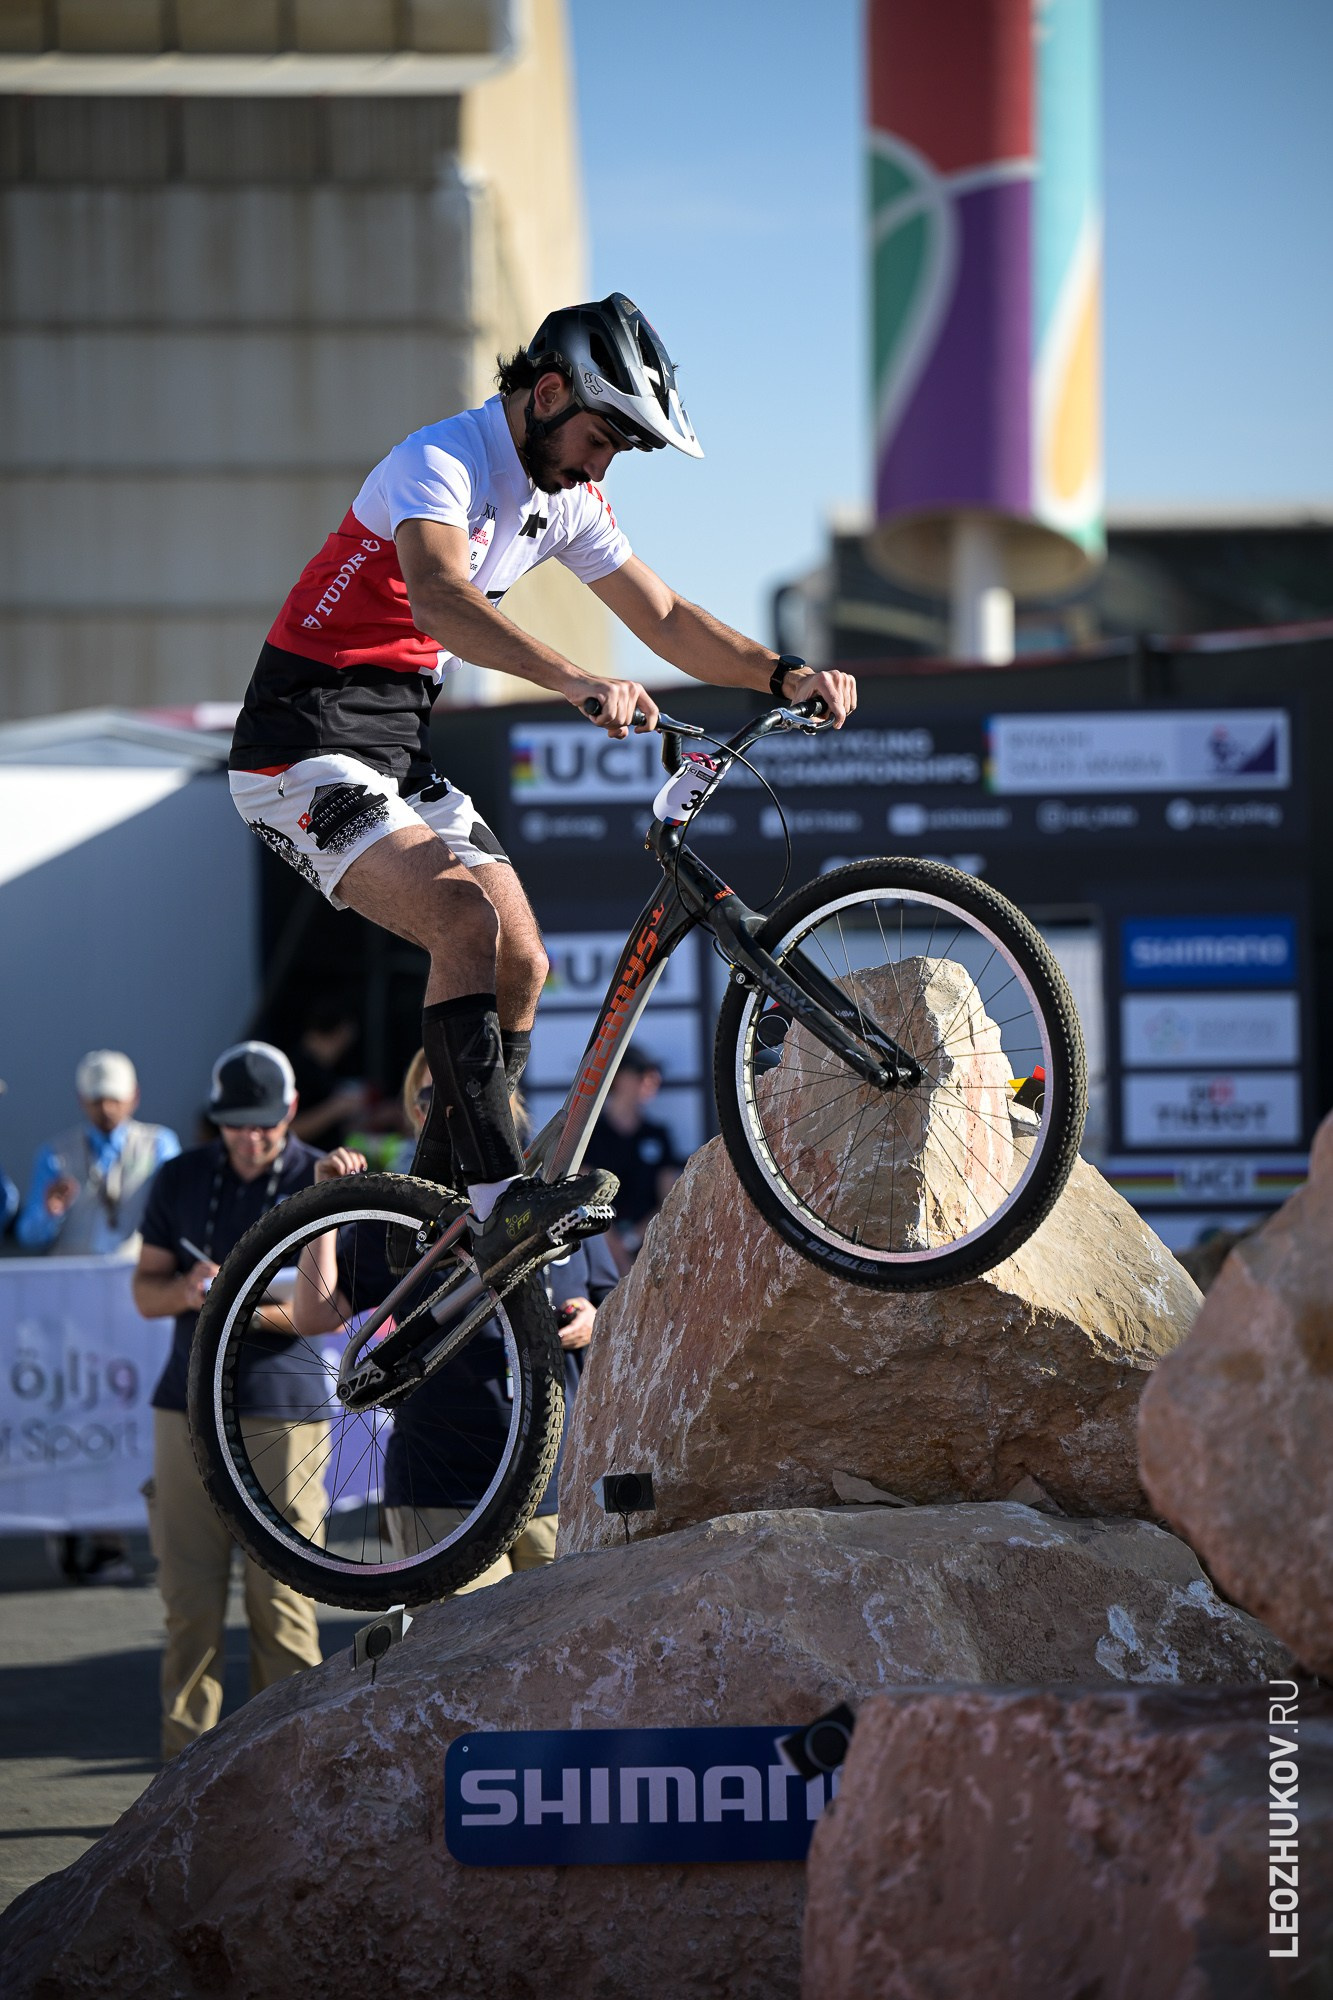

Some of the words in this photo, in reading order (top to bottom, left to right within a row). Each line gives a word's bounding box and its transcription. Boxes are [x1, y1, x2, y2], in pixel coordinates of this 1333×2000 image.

[470, 534, 489, 547] CYCLING
[315, 551, 367, 616] TUDOR
[545, 741, 654, 784] UCI
[1130, 935, 1288, 967] SHIMANO
[827, 1254, 860, 1270] TIRE
[460, 1765, 842, 1826] SHIMAN
